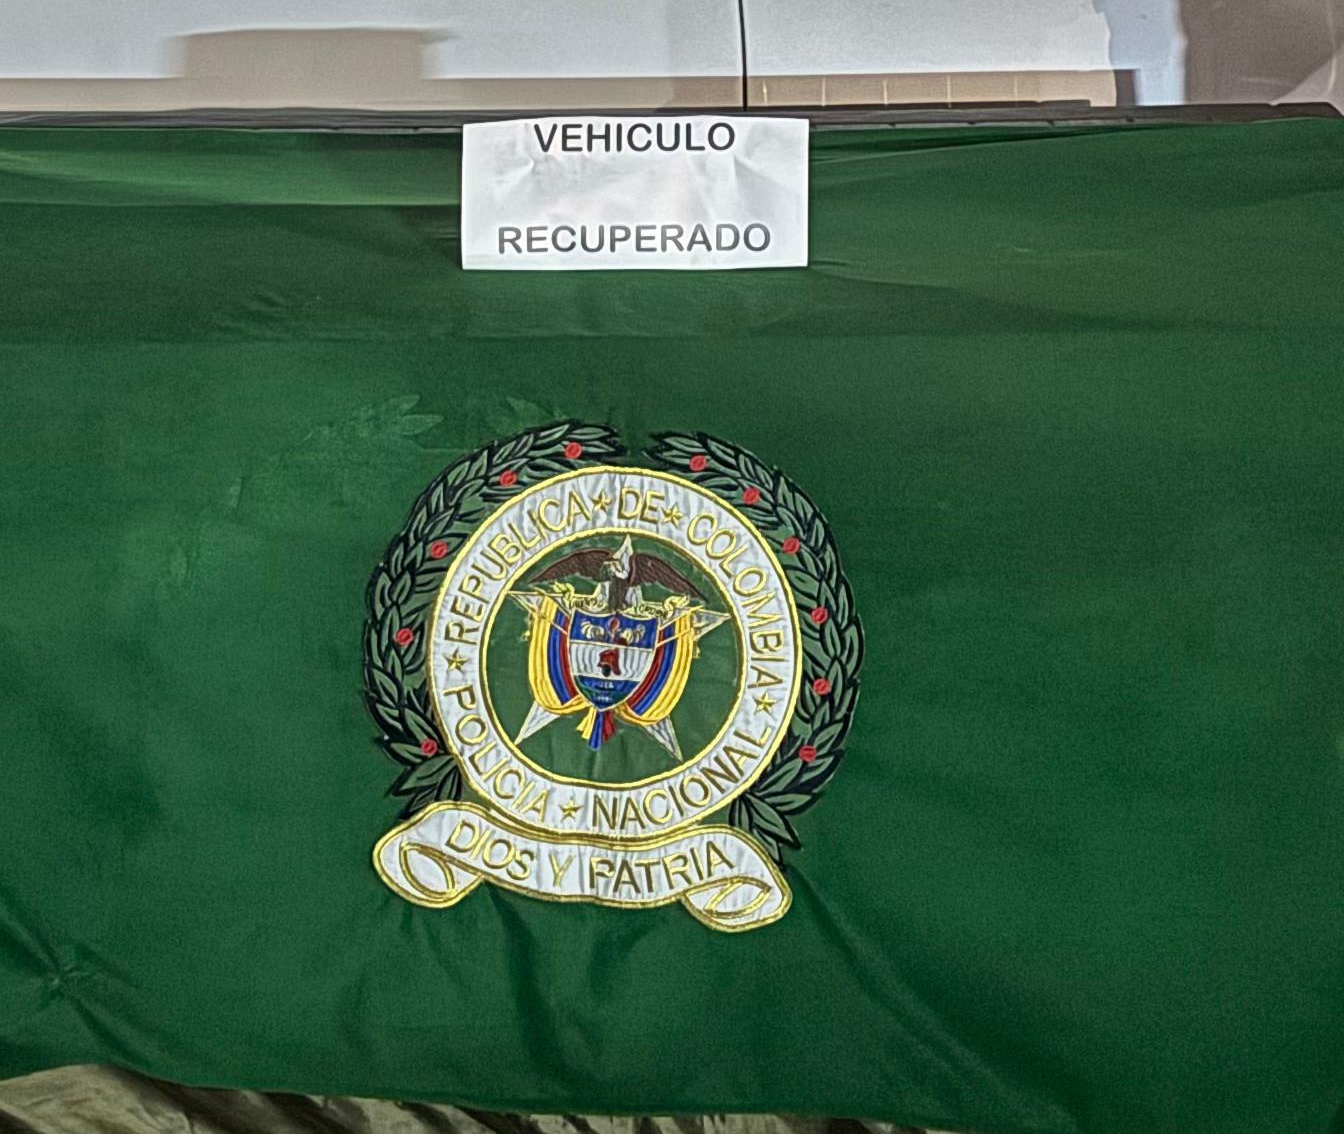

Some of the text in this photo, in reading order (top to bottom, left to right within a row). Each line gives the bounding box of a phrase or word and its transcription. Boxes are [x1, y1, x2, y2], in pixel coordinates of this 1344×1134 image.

[533, 122, 736, 153] VEHICULO
[498, 223, 771, 254] RECUPERADO
[444, 487, 787, 691] REPUBLICA DE COLOMBIA
[442, 684, 776, 831] POLICIA NACIONAL
[446, 821, 736, 894] DIOS Y PATRIA
